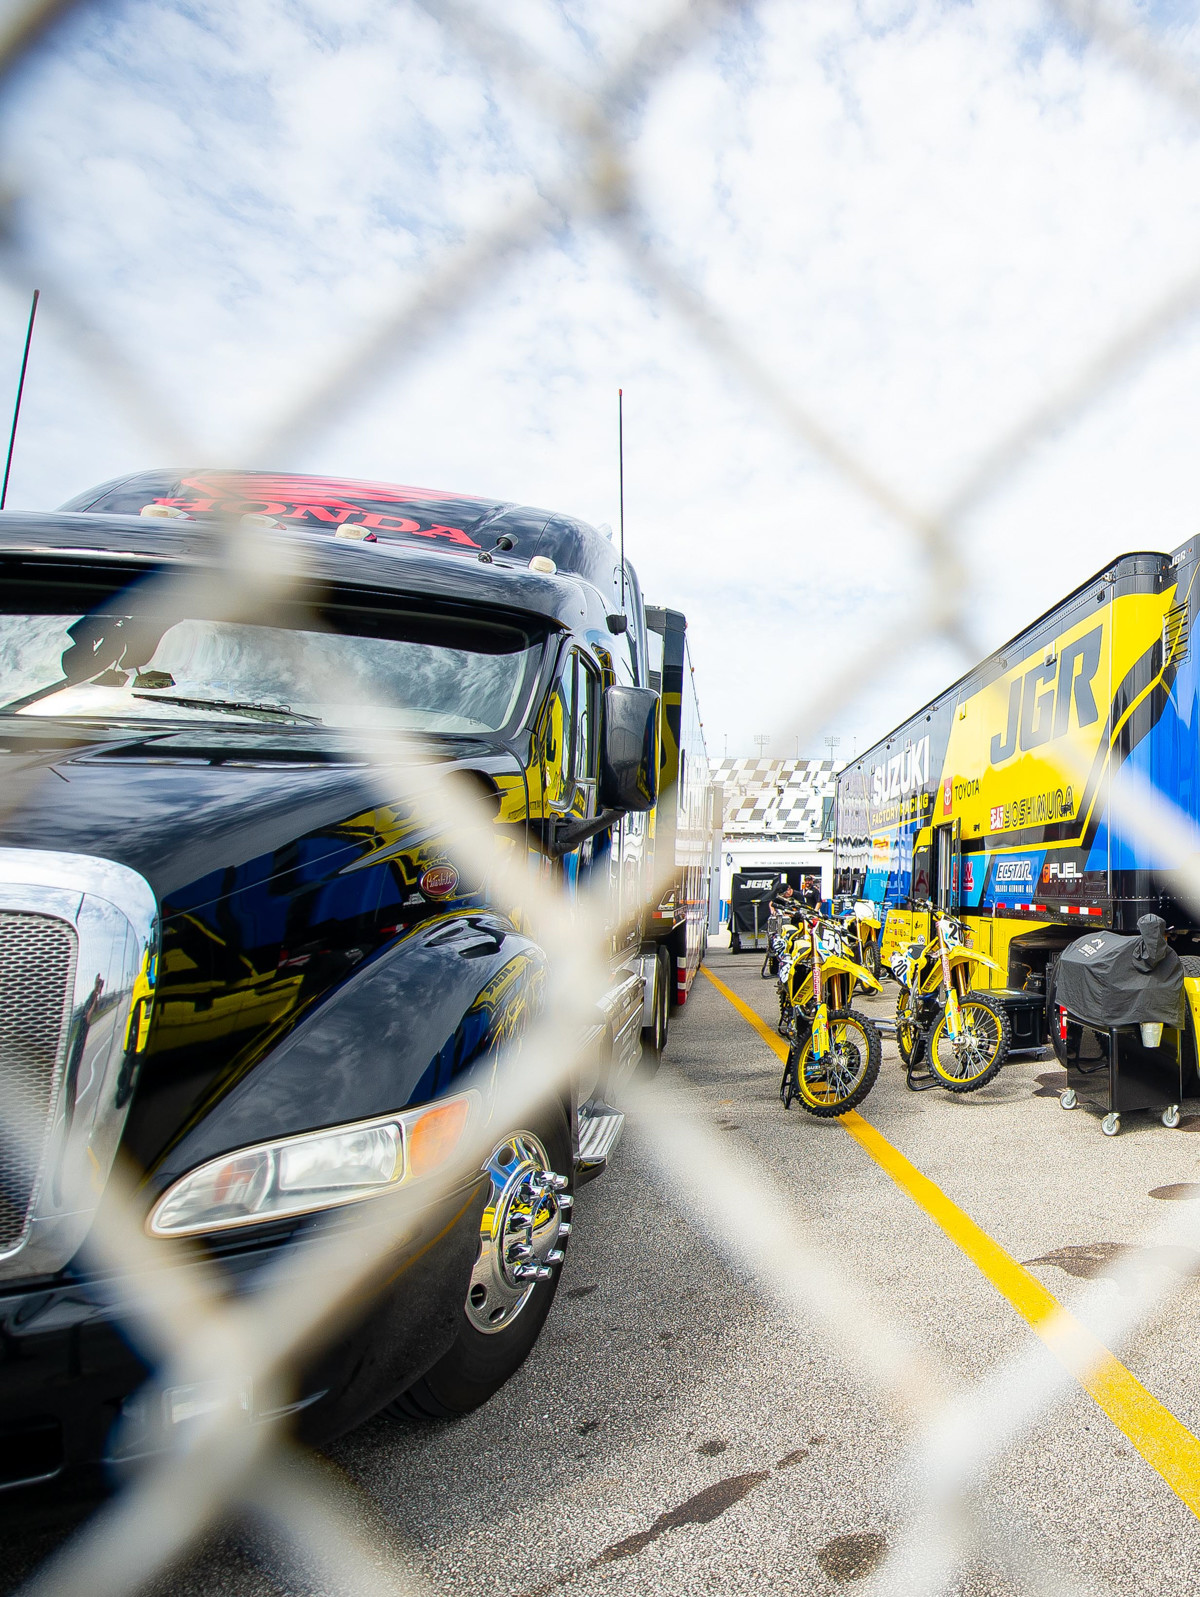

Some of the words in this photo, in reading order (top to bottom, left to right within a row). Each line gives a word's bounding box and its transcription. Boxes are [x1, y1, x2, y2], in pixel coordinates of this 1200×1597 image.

[139, 497, 482, 548] HONDA
[990, 624, 1103, 764] JGR
[873, 735, 930, 806] SUZUKI
[954, 778, 980, 801] TOYOTA
[872, 804, 899, 826] FACTORY
[900, 793, 929, 816] RACING
[1004, 785, 1075, 828] YOSHIMURA
[740, 880, 773, 889] JGR
[996, 861, 1033, 881] ECSTAR
[1049, 862, 1084, 879] FUEL
